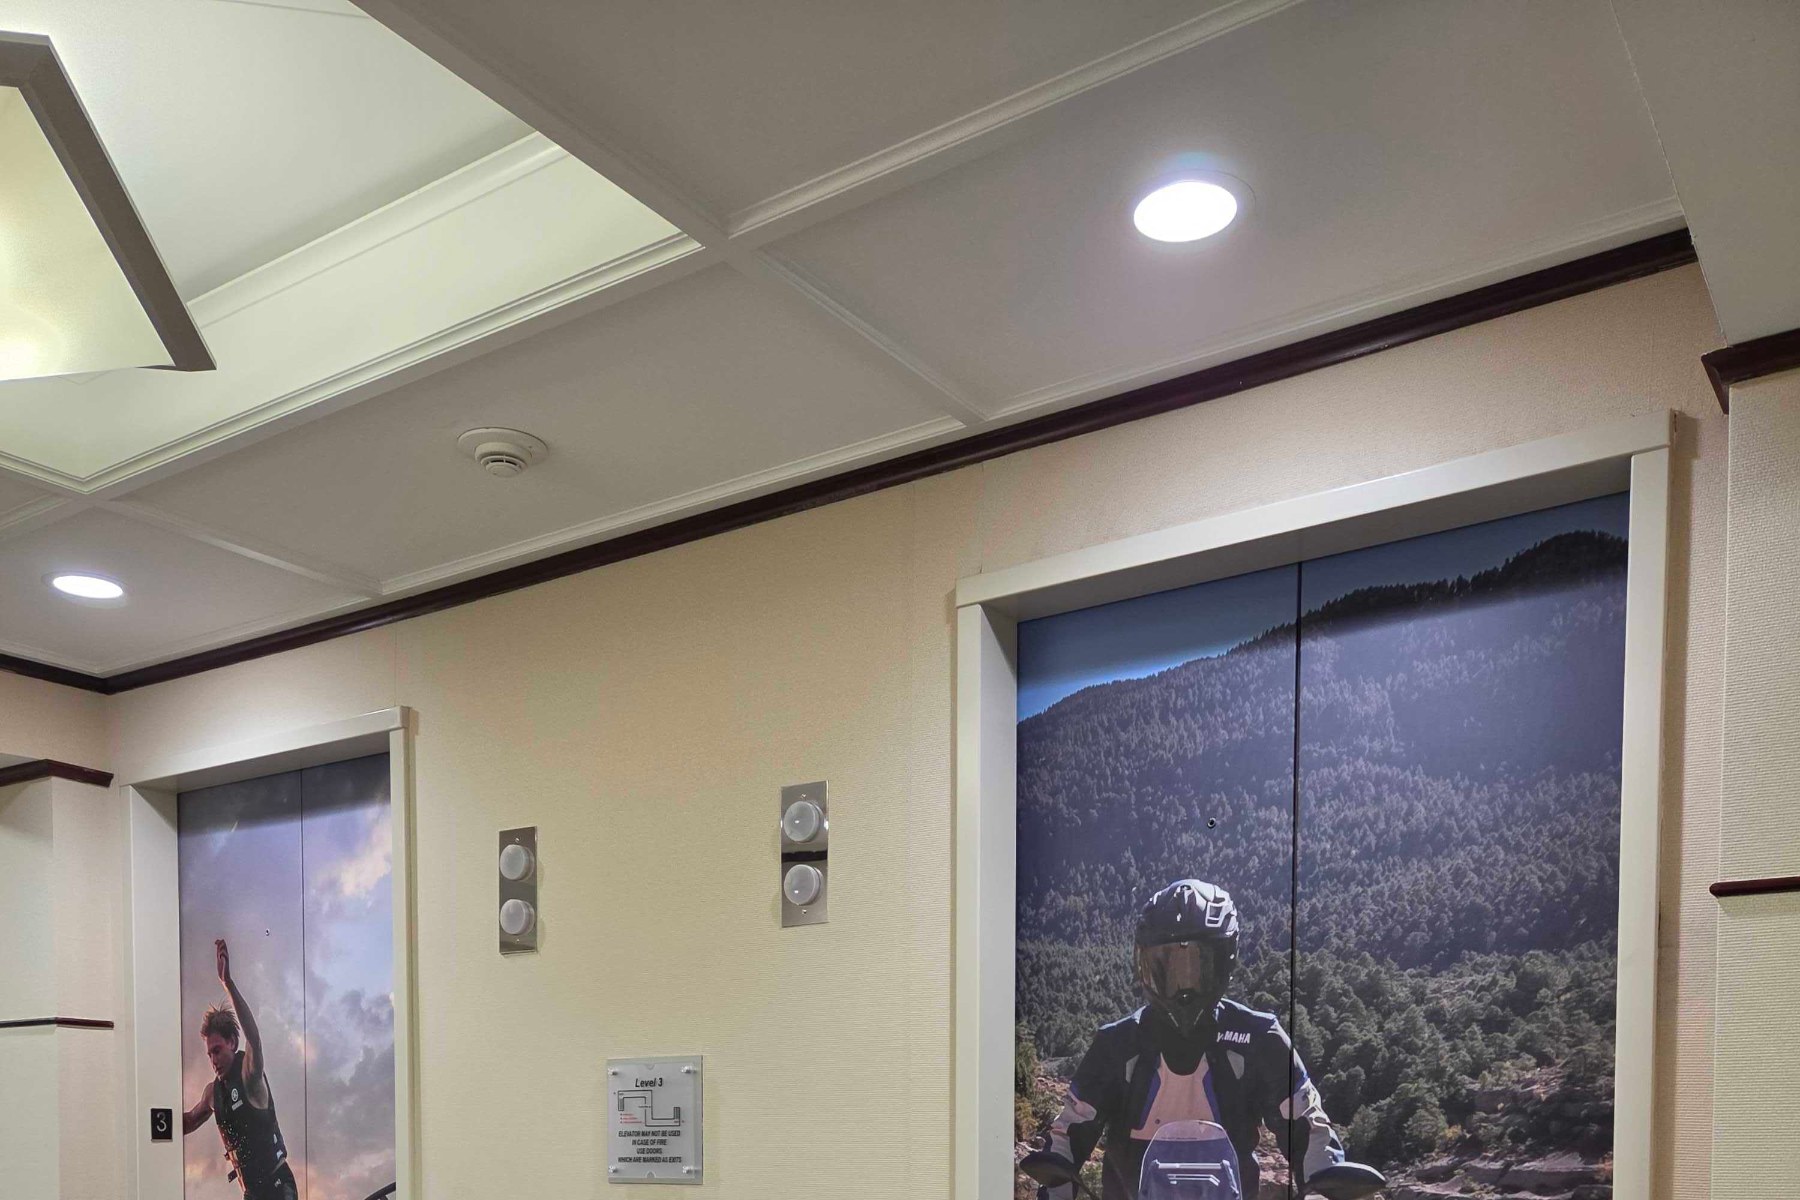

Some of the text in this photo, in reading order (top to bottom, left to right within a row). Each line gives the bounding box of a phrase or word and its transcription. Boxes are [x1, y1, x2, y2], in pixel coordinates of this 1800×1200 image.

[1216, 1030, 1251, 1044] YMAHA
[635, 1077, 663, 1088] Level 3
[156, 1111, 167, 1132] 3
